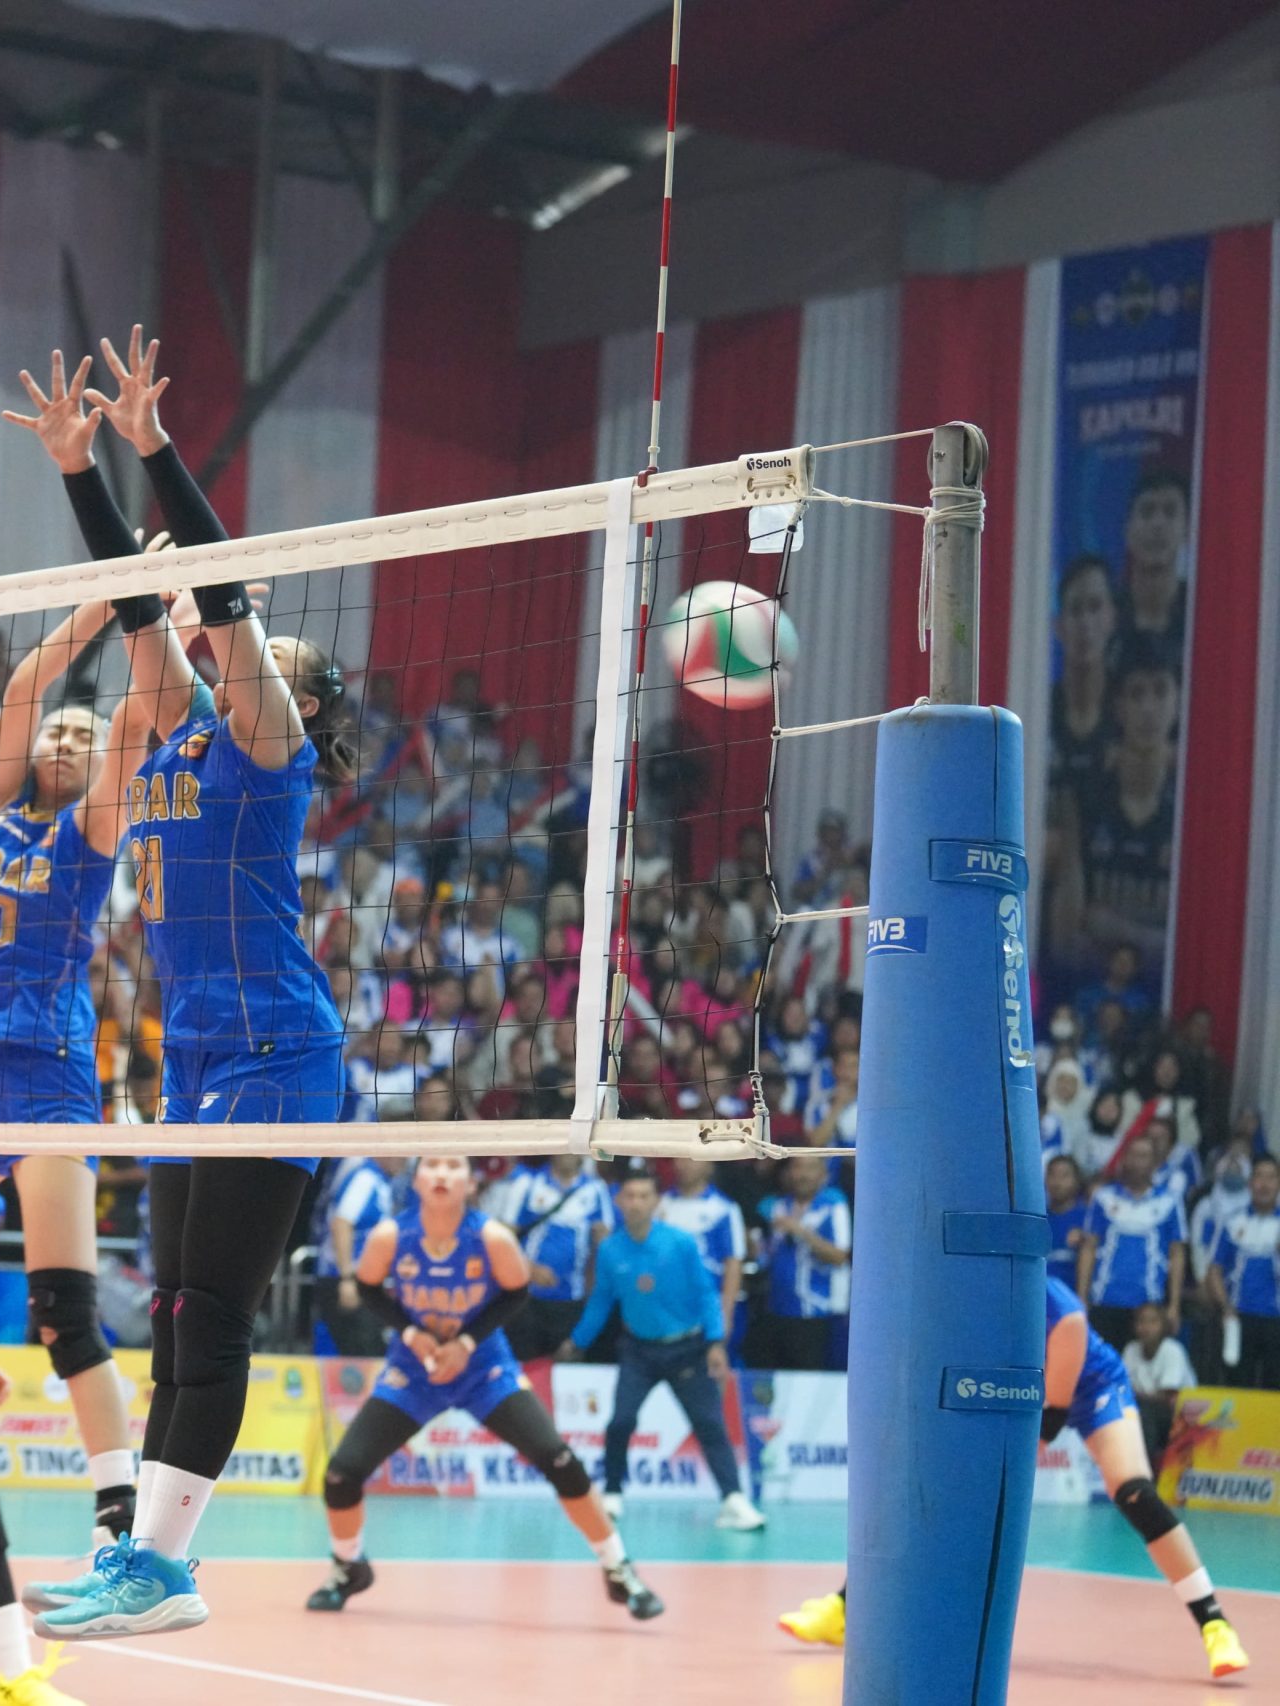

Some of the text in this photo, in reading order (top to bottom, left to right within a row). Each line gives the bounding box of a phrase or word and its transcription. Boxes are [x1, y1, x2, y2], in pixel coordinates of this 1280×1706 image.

[755, 456, 791, 470] Senoh
[125, 771, 201, 825] BAR
[979, 1382, 1040, 1401] Senoh
[21, 1446, 88, 1475] TING
